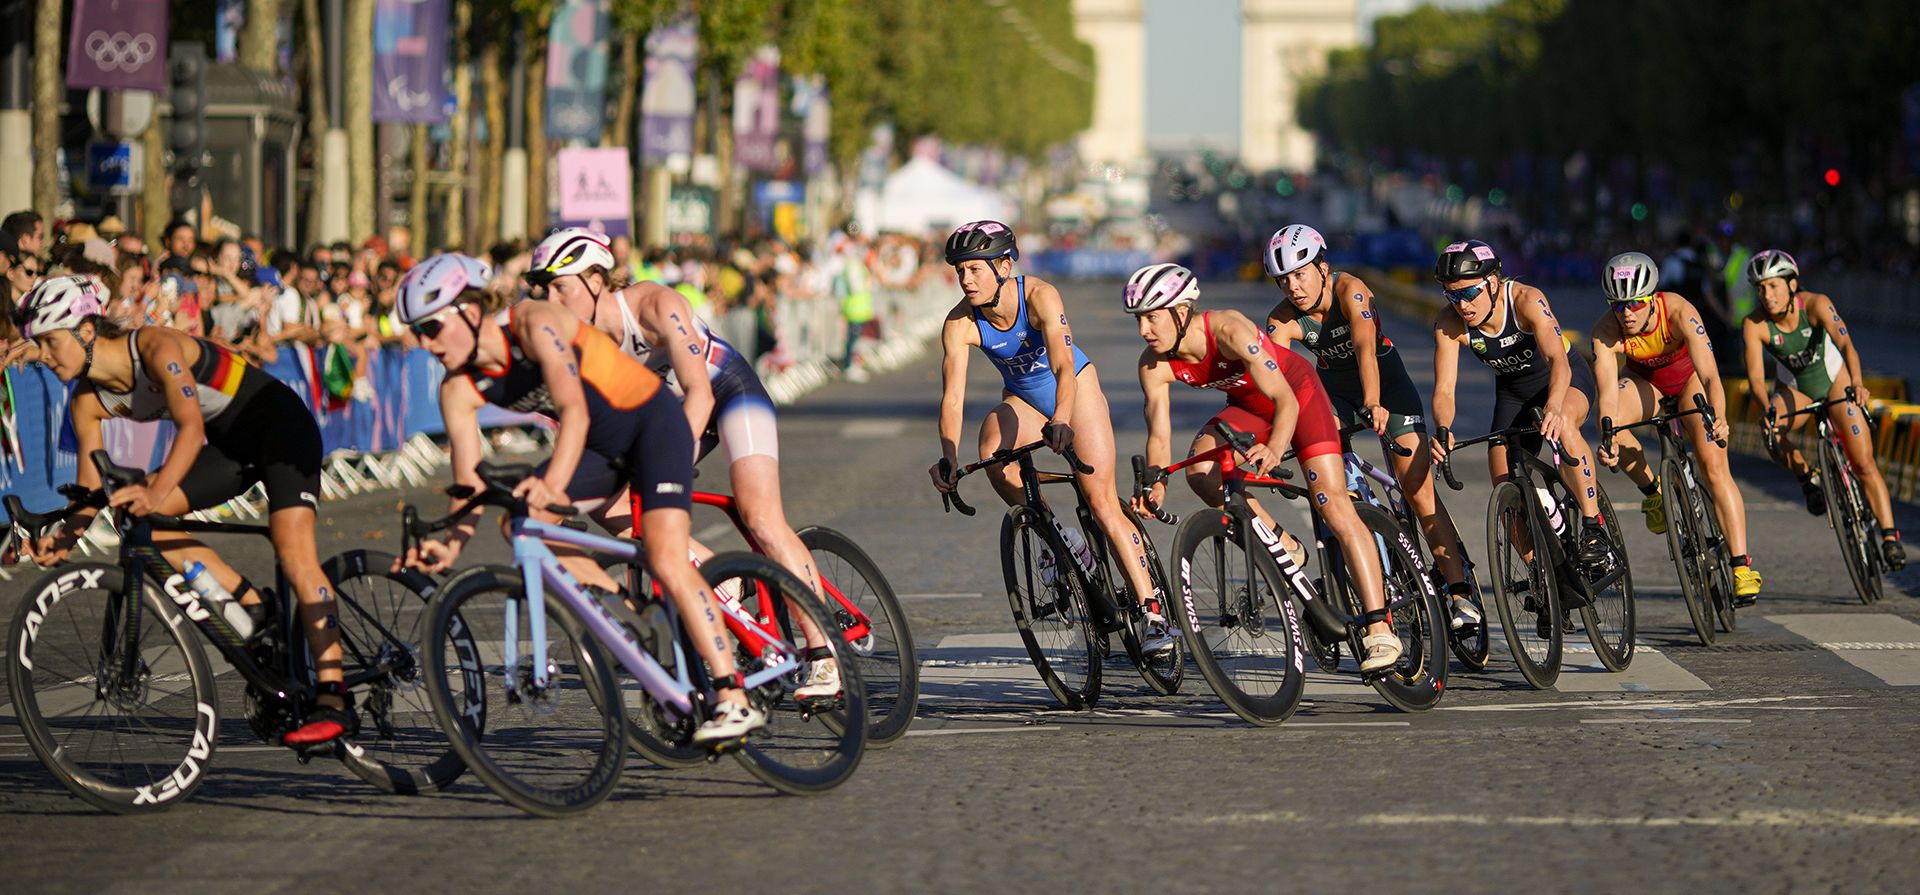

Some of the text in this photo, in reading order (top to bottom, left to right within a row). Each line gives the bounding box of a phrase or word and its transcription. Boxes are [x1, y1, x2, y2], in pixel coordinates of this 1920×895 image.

[1291, 226, 1304, 248] TREK
[1353, 292, 1364, 303] 9
[1059, 313, 1068, 326] 8
[1360, 309, 1372, 320] B
[1064, 334, 1072, 347] B
[687, 343, 701, 356] B
[1247, 344, 1260, 355] 6
[166, 361, 182, 376] 2
[1007, 360, 1048, 376] ITA
[1263, 359, 1278, 372] B
[180, 385, 196, 398] B
[1308, 468, 1318, 482] 6
[1316, 492, 1328, 506] B
[1586, 486, 1595, 499] B
[1131, 532, 1140, 545] 8
[1139, 555, 1147, 568] B
[1398, 532, 1436, 597] DT SWISS
[1181, 556, 1201, 633] DT SWISS
[19, 568, 105, 671] CADEX
[1284, 600, 1304, 674] DT SWISS
[132, 701, 216, 805] CADEX
